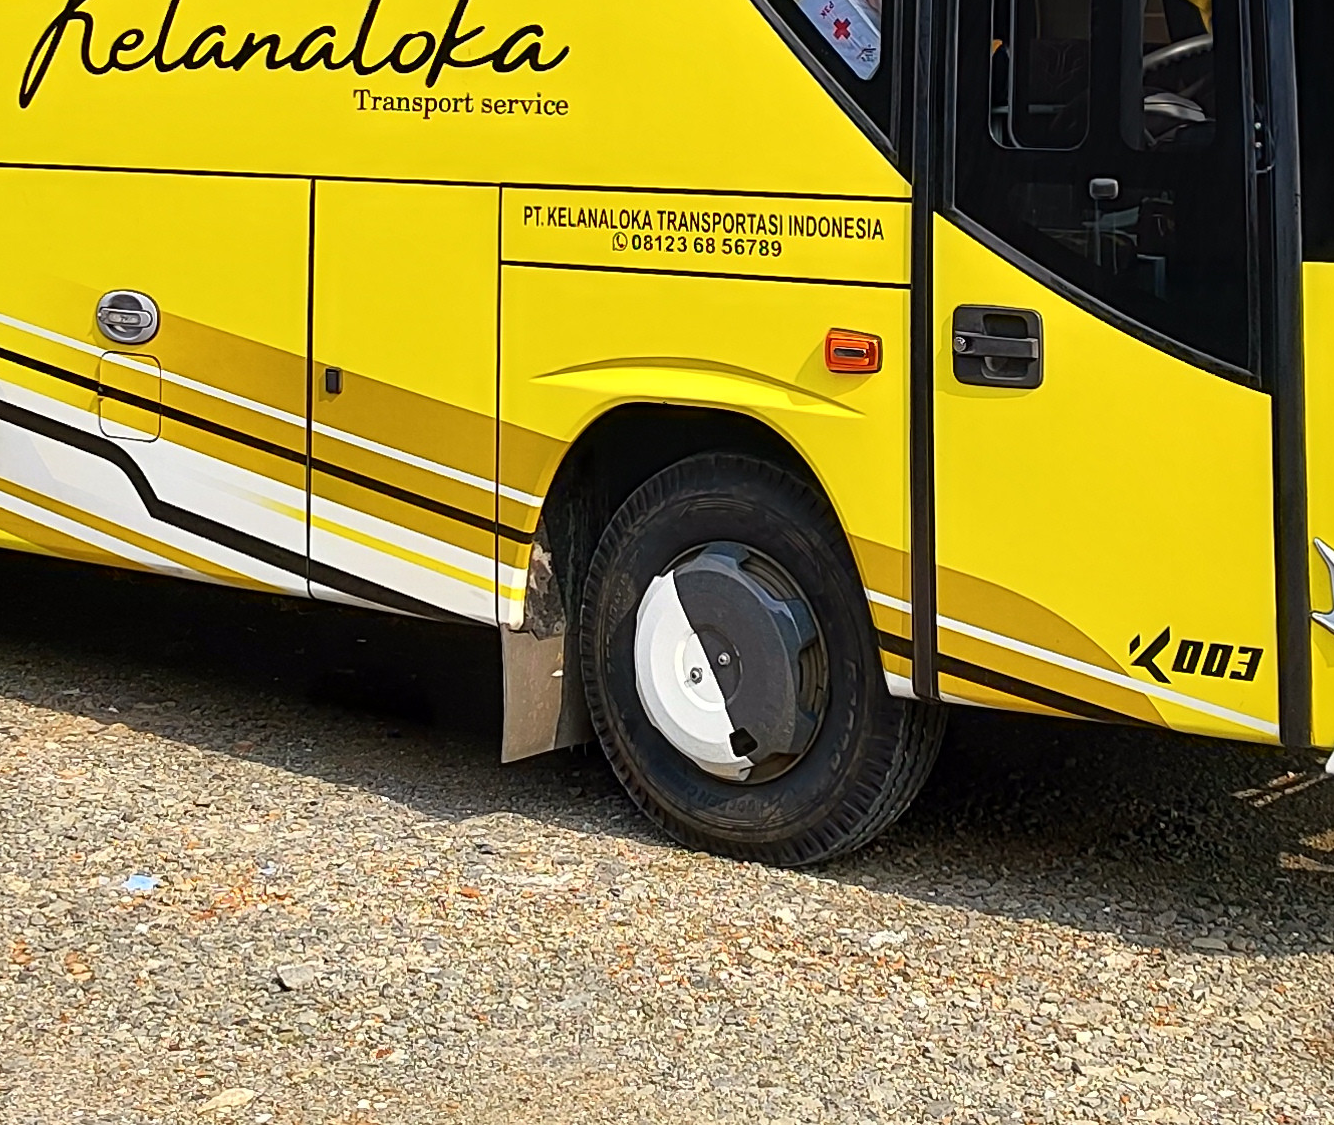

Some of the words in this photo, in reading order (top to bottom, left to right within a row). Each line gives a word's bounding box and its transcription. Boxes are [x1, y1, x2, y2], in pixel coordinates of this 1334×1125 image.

[354, 88, 474, 120] Transport
[482, 92, 570, 118] service
[547, 206, 653, 232] KELANALOKA
[657, 210, 783, 237] TRANSPORTASI
[788, 215, 885, 241] INDONESIA
[632, 234, 687, 253] 08123
[693, 236, 716, 255] 68
[722, 238, 783, 258] 56789
